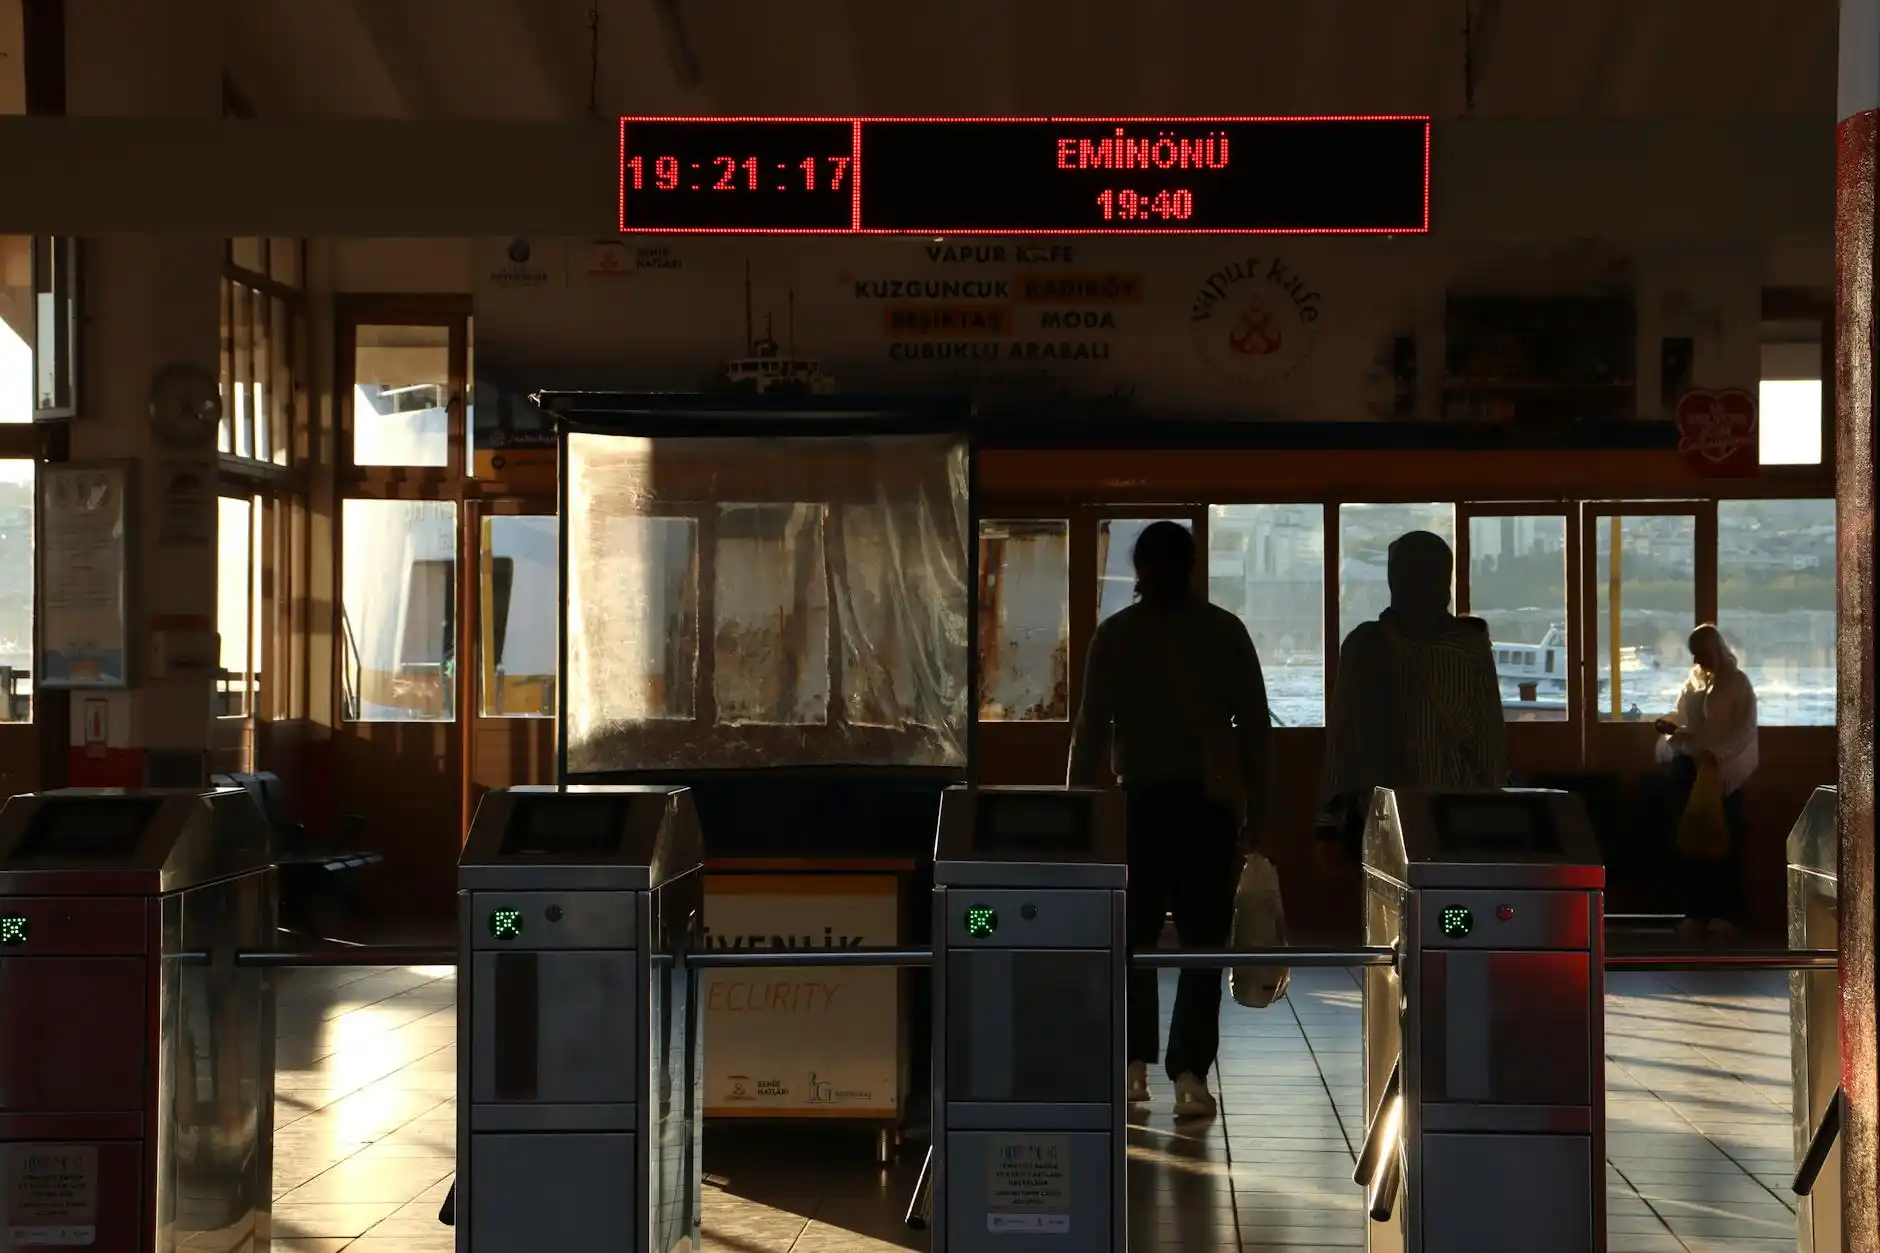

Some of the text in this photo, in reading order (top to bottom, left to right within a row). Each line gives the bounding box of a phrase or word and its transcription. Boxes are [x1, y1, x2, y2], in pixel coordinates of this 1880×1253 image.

[1056, 127, 1230, 169] EMİNÖNÜ
[627, 155, 850, 191] 19:21:17
[1096, 189, 1192, 220] 19:40
[925, 245, 1006, 263] VAPUR
[854, 280, 1010, 299] KUZGUNCUK
[1191, 258, 1261, 323] vapur
[1040, 310, 1117, 330] MODA
[1009, 342, 1110, 361] ARABALI
